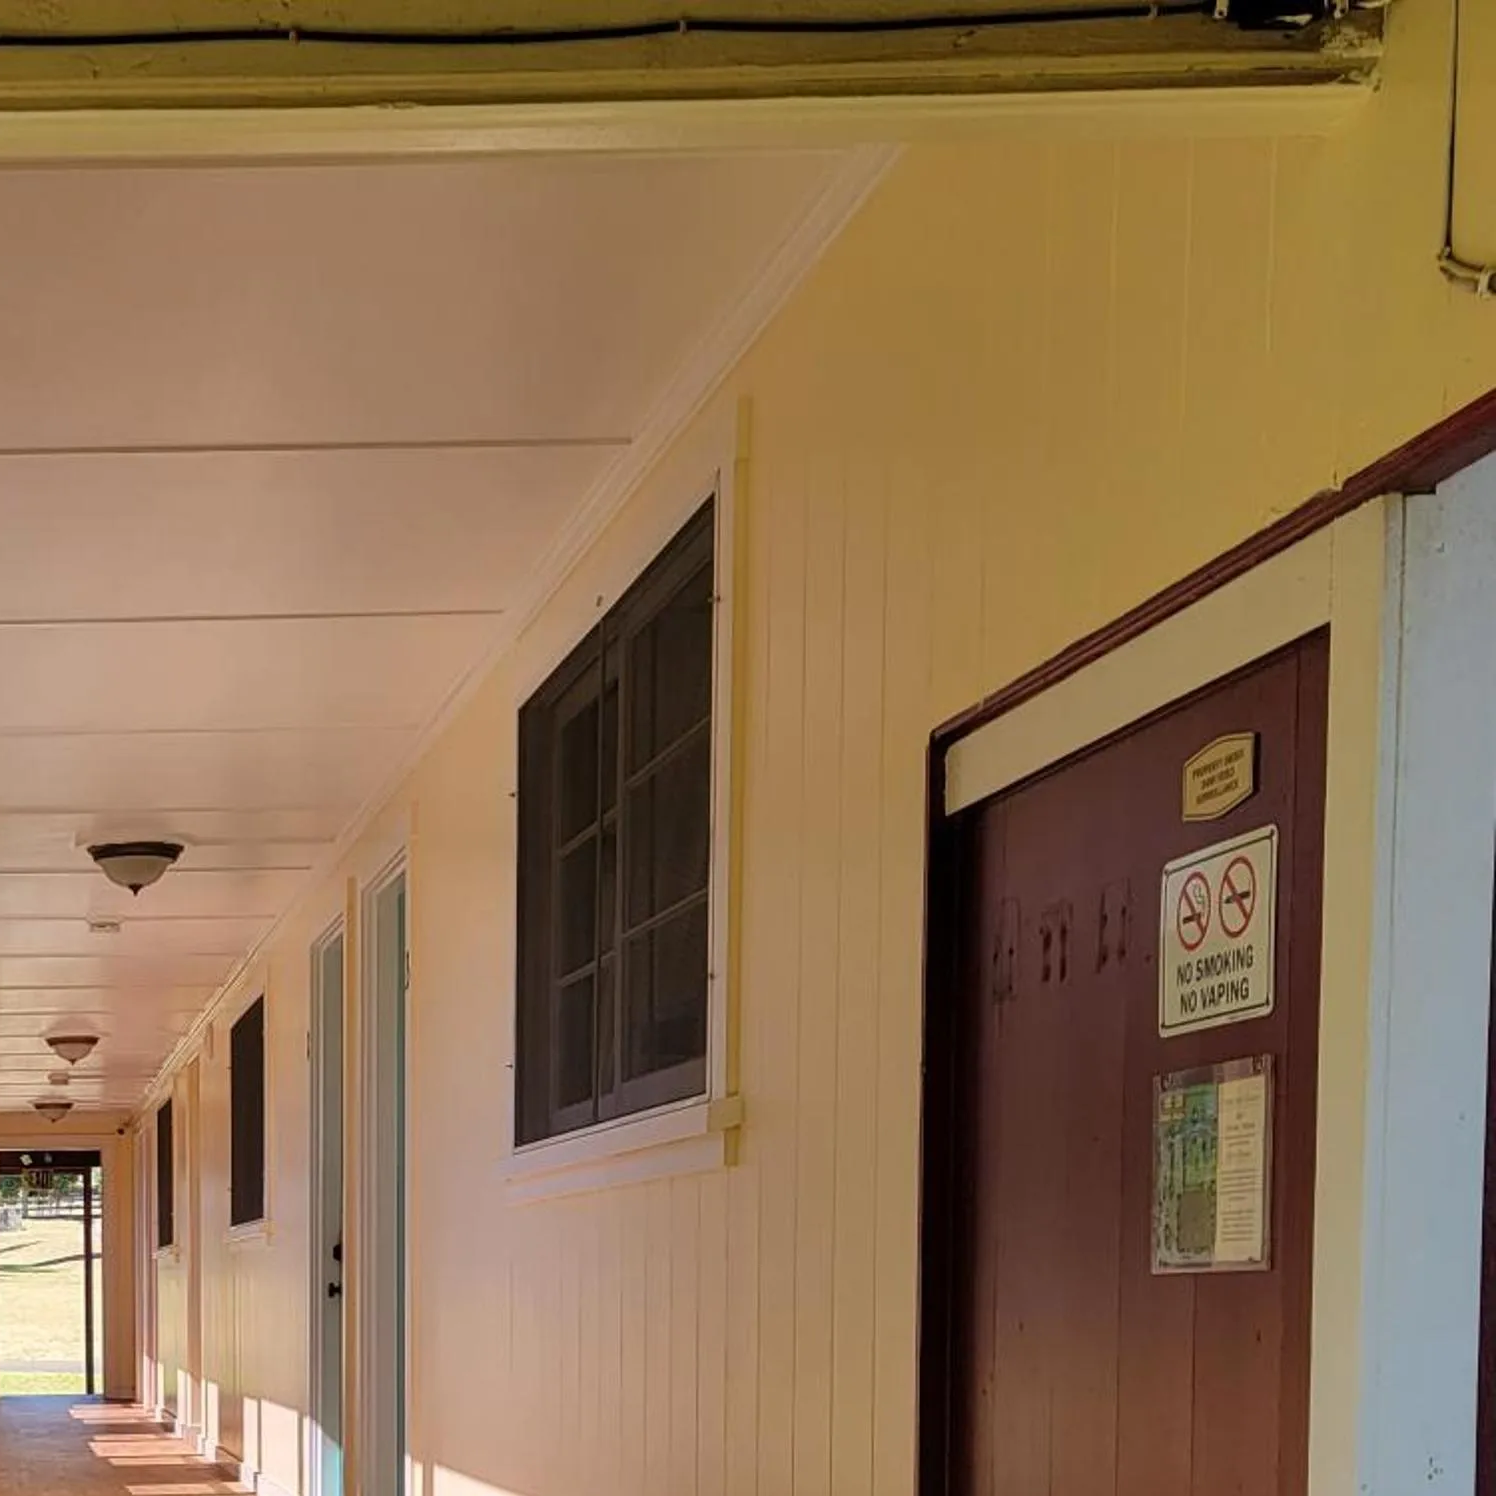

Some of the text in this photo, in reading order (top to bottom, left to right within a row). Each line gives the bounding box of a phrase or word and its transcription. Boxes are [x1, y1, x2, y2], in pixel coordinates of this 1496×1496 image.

[1176, 945, 1253, 986] NO SMOKING
[1180, 977, 1249, 1016] NO VAPING
